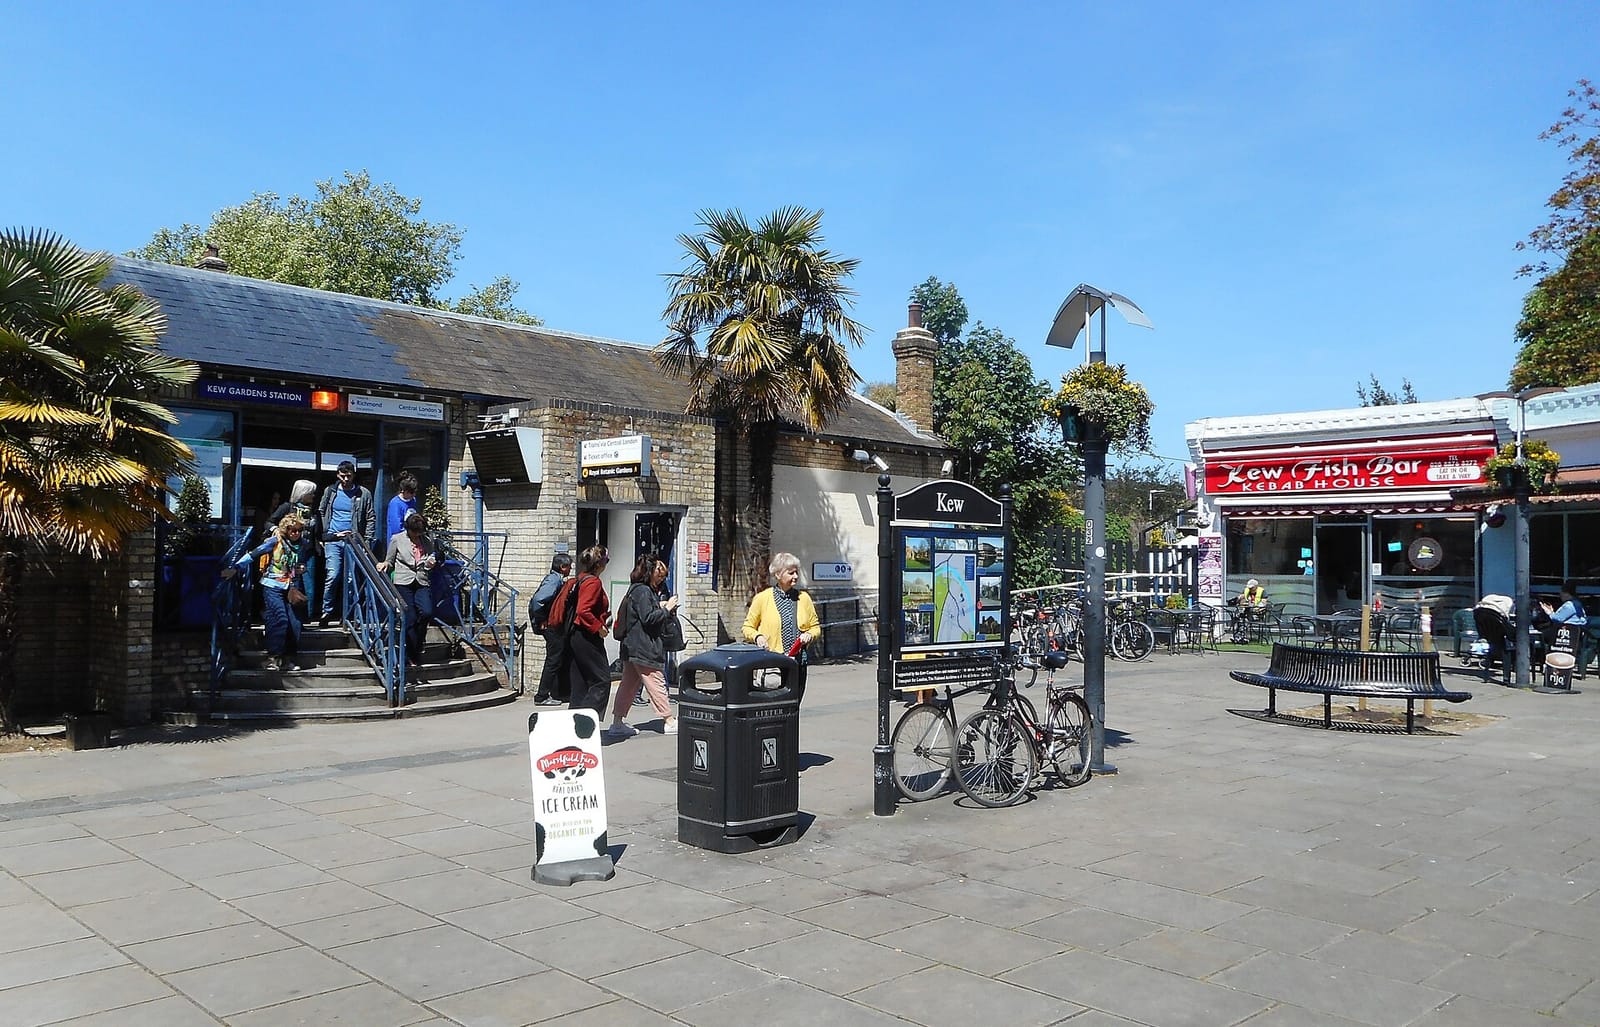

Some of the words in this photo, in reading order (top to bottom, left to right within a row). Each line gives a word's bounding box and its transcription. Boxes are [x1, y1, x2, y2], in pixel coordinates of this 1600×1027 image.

[207, 384, 227, 394] KEW
[228, 387, 267, 398] GARDENS
[269, 391, 302, 401] STATION
[356, 400, 383, 408] Richmond
[418, 406, 438, 414] London
[588, 469, 600, 477] Royal
[616, 466, 633, 474] Gardens
[1217, 463, 1284, 488] Kew
[1291, 458, 1358, 482] Fish
[1367, 456, 1421, 476] Bar
[1242, 480, 1304, 491] KEBAB
[1315, 476, 1395, 488] HOUSE
[936, 492, 965, 512] Kew
[689, 710, 714, 720] LITTER
[755, 708, 784, 717] LITTER
[542, 798, 559, 814] ICE
[563, 794, 598, 811] CREAM
[548, 828, 577, 839] ORGANIC
